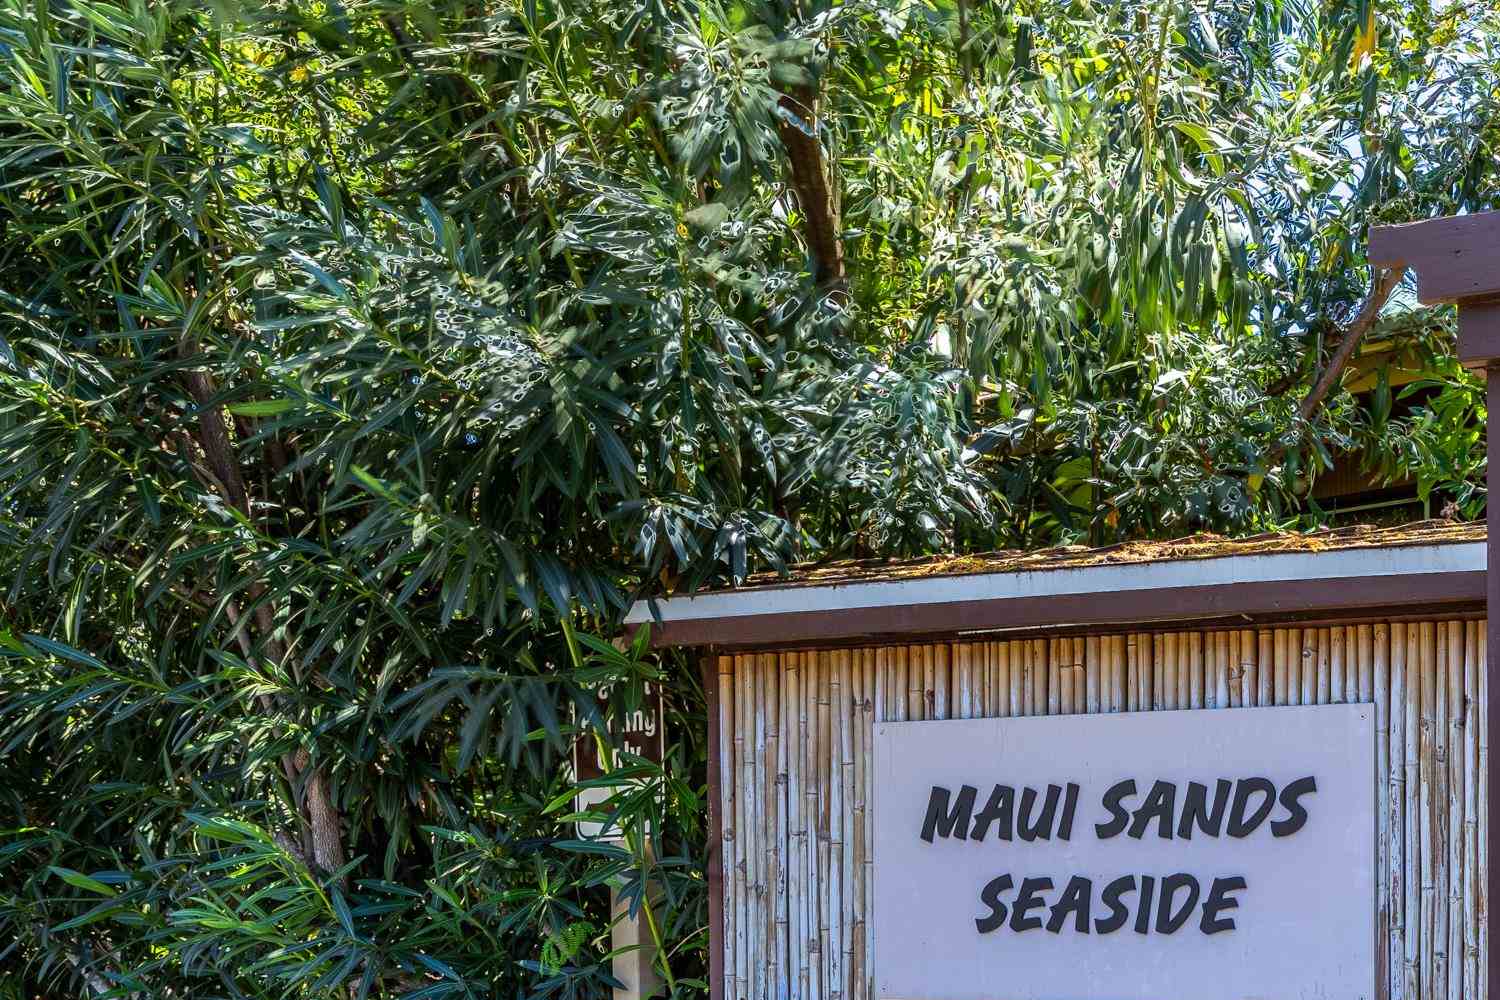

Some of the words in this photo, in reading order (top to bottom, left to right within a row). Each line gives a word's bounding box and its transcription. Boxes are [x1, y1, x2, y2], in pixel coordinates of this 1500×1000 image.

[920, 782, 1080, 842] MAUI
[1094, 776, 1317, 841] SANDS
[975, 872, 1248, 935] SEASIDE
